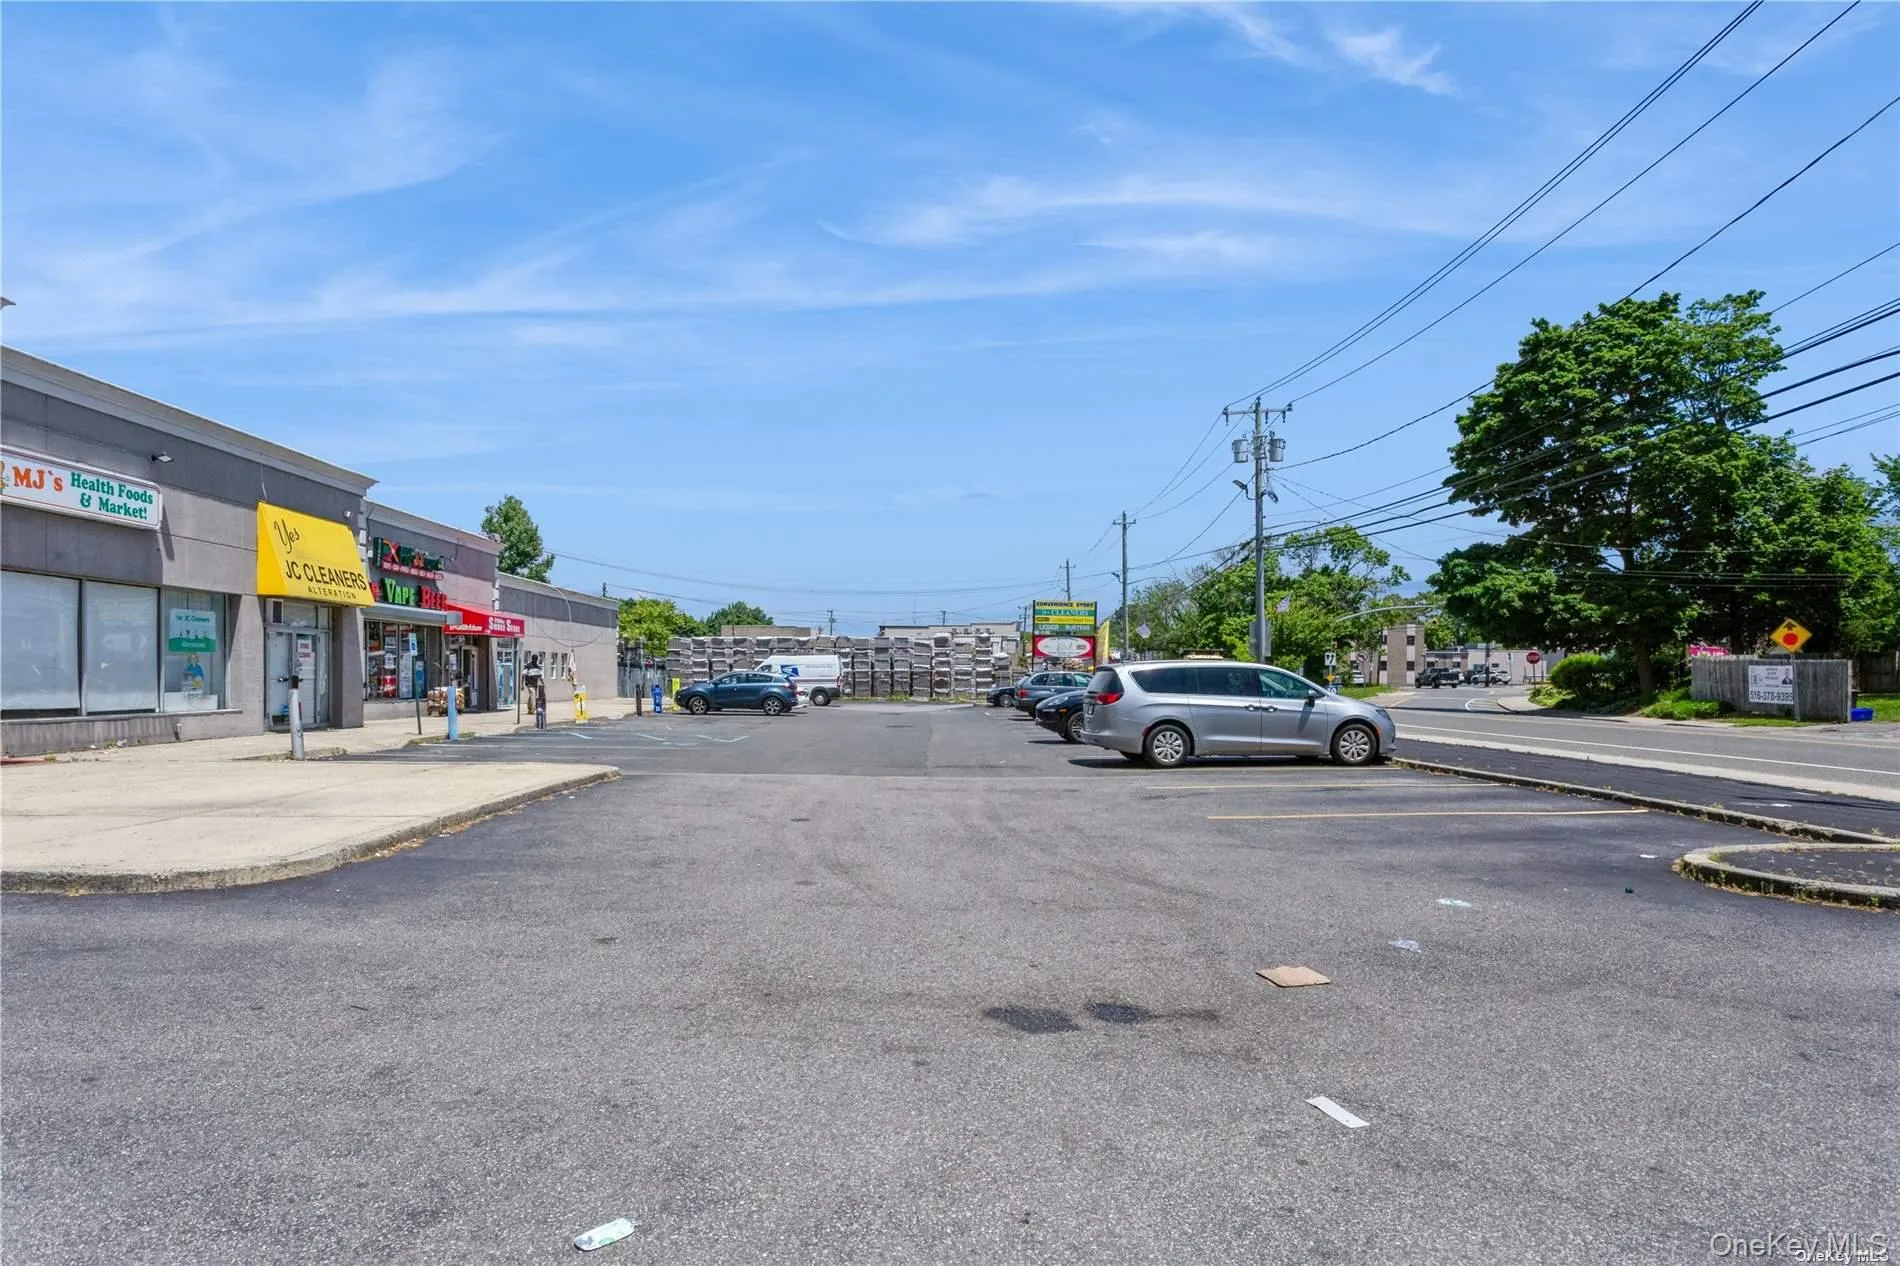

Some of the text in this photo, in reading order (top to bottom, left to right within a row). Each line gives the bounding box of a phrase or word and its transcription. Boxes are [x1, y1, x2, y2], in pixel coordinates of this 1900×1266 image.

[70, 472, 115, 496] Health
[118, 484, 153, 505] Foods
[80, 492, 148, 520] & Market!
[273, 518, 300, 554] Yes
[286, 560, 302, 580] JC
[303, 563, 367, 591] CLEANERS
[308, 586, 357, 600] ALTERATION
[384, 577, 416, 606] VAPE
